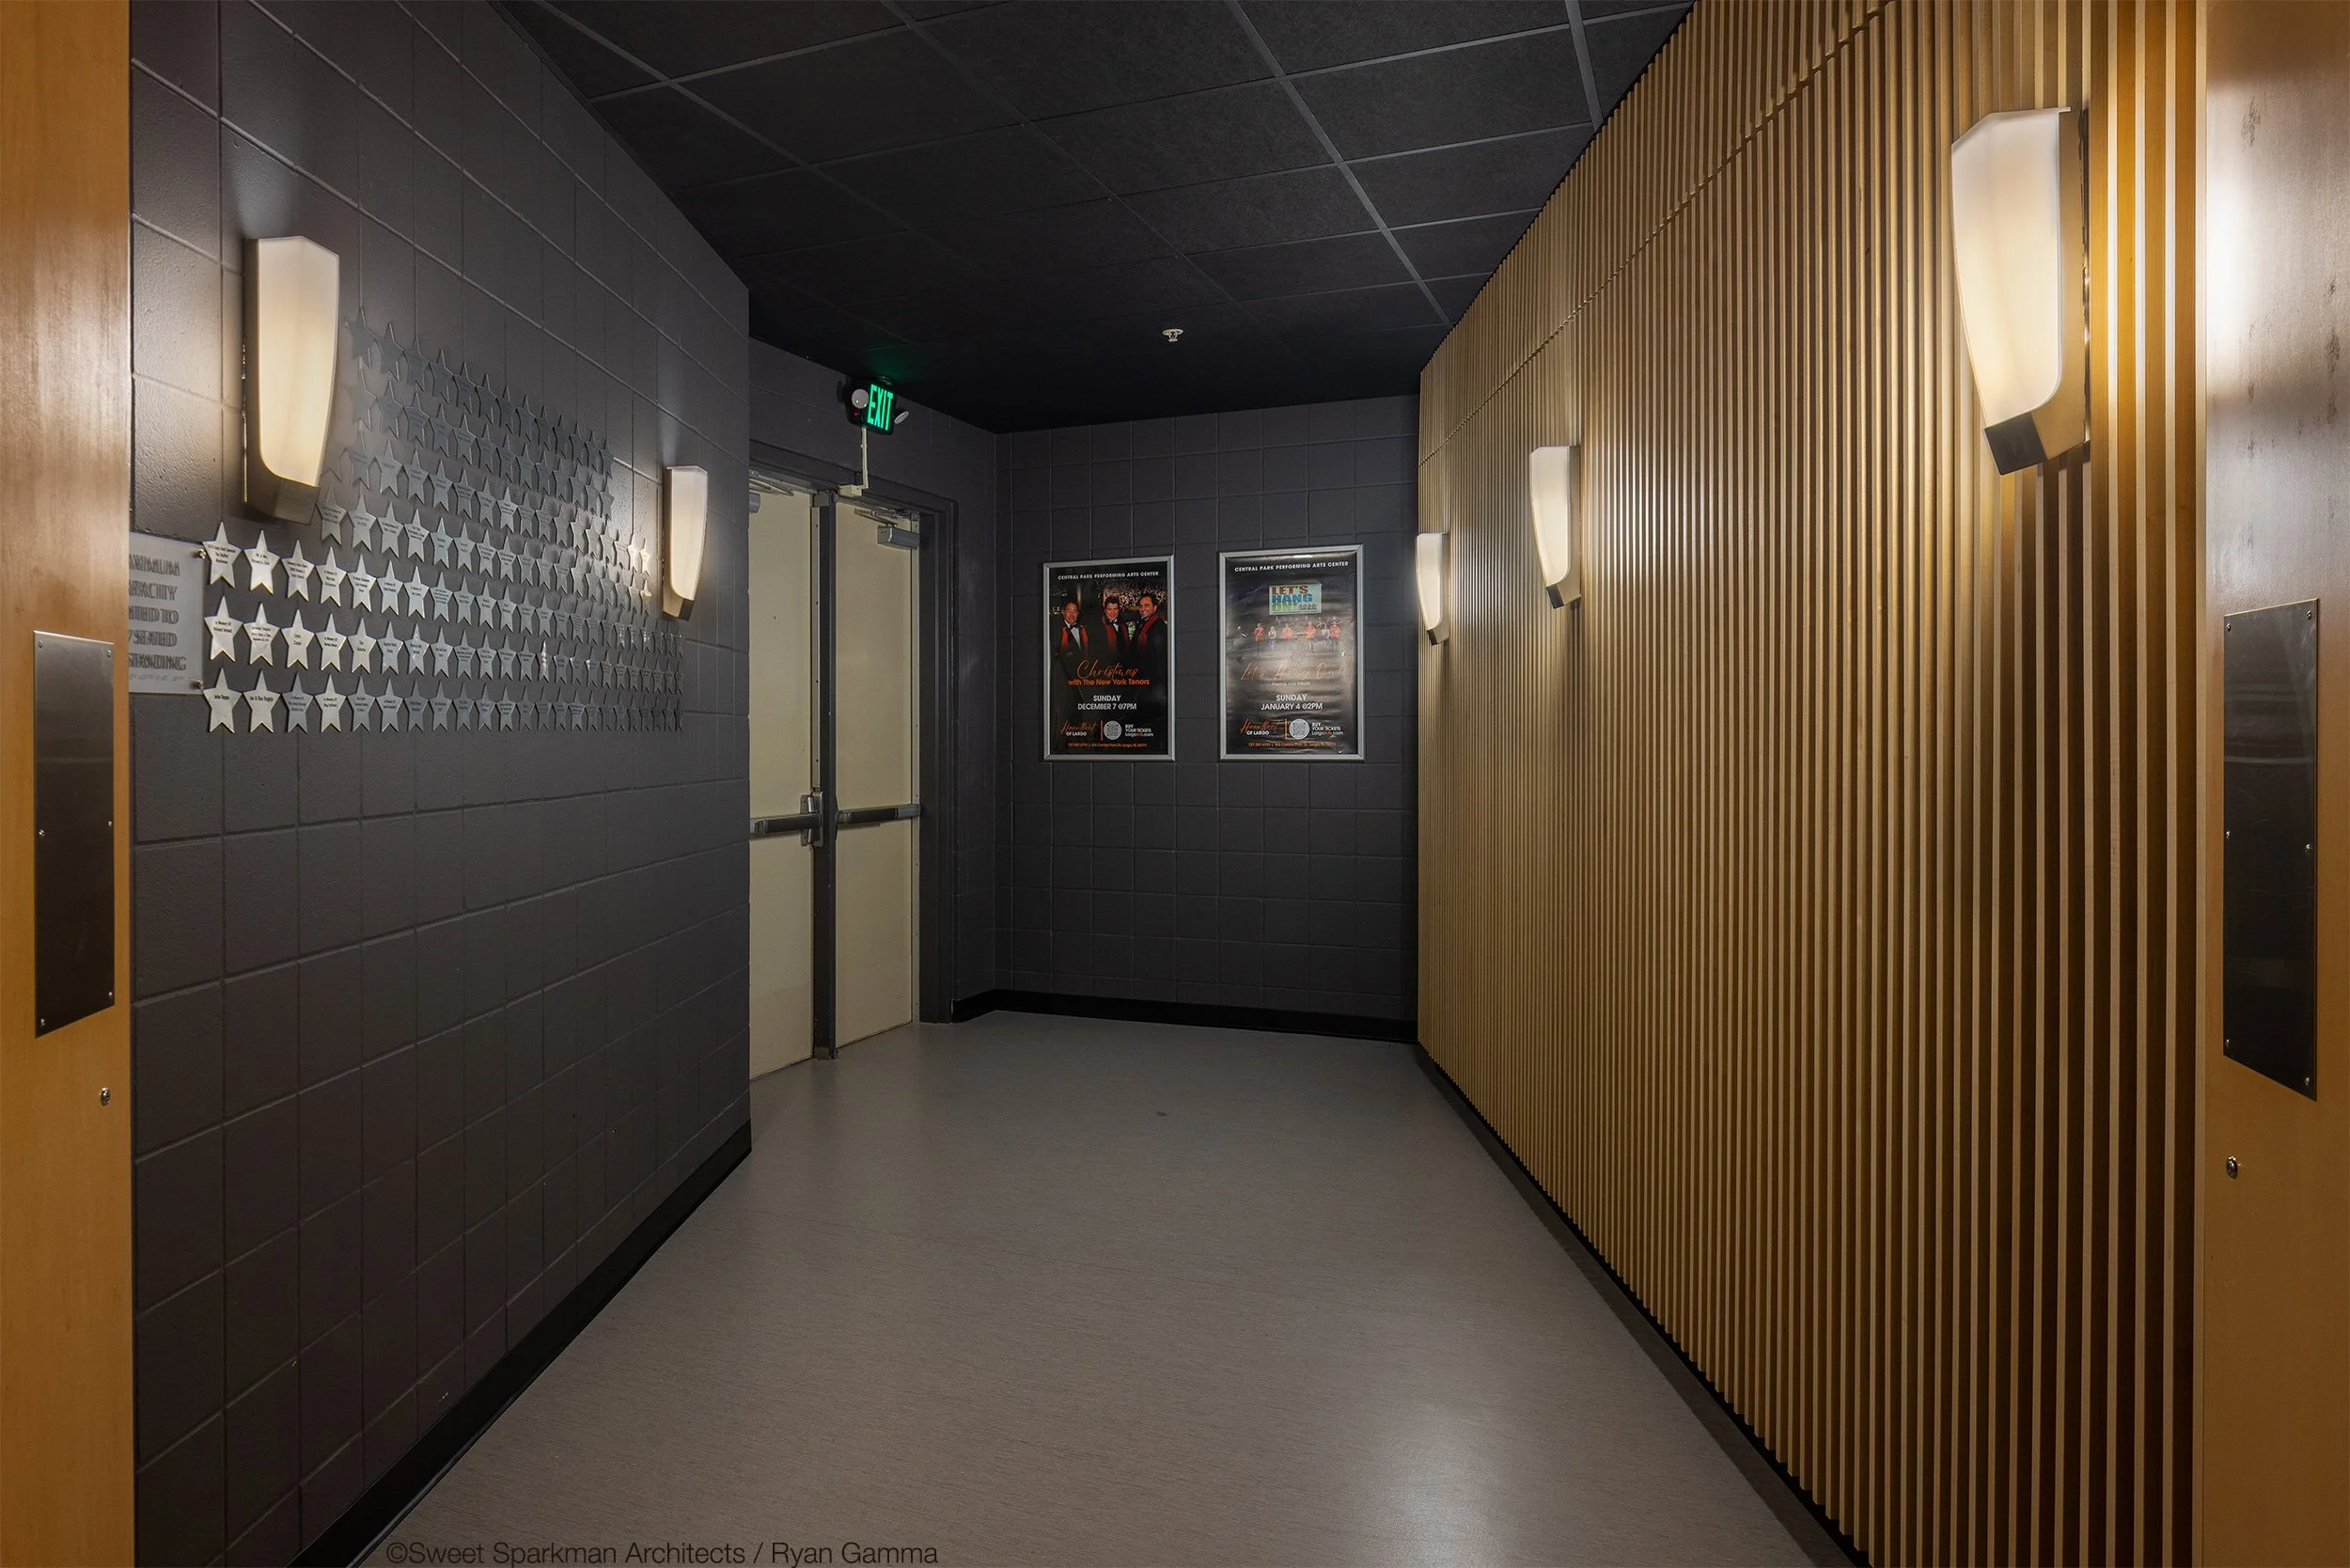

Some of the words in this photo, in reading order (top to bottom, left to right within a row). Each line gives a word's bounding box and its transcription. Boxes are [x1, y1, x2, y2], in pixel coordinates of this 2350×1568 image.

[868, 384, 894, 431] EXIT
[129, 553, 180, 576] AXIMUM
[129, 579, 178, 601] APACITY
[1272, 586, 1308, 595] LET'S
[1272, 594, 1312, 603] HANG
[129, 605, 160, 622] MITED
[161, 608, 179, 625] TO
[133, 630, 178, 647] SEATED
[1077, 660, 1138, 679] Christmas
